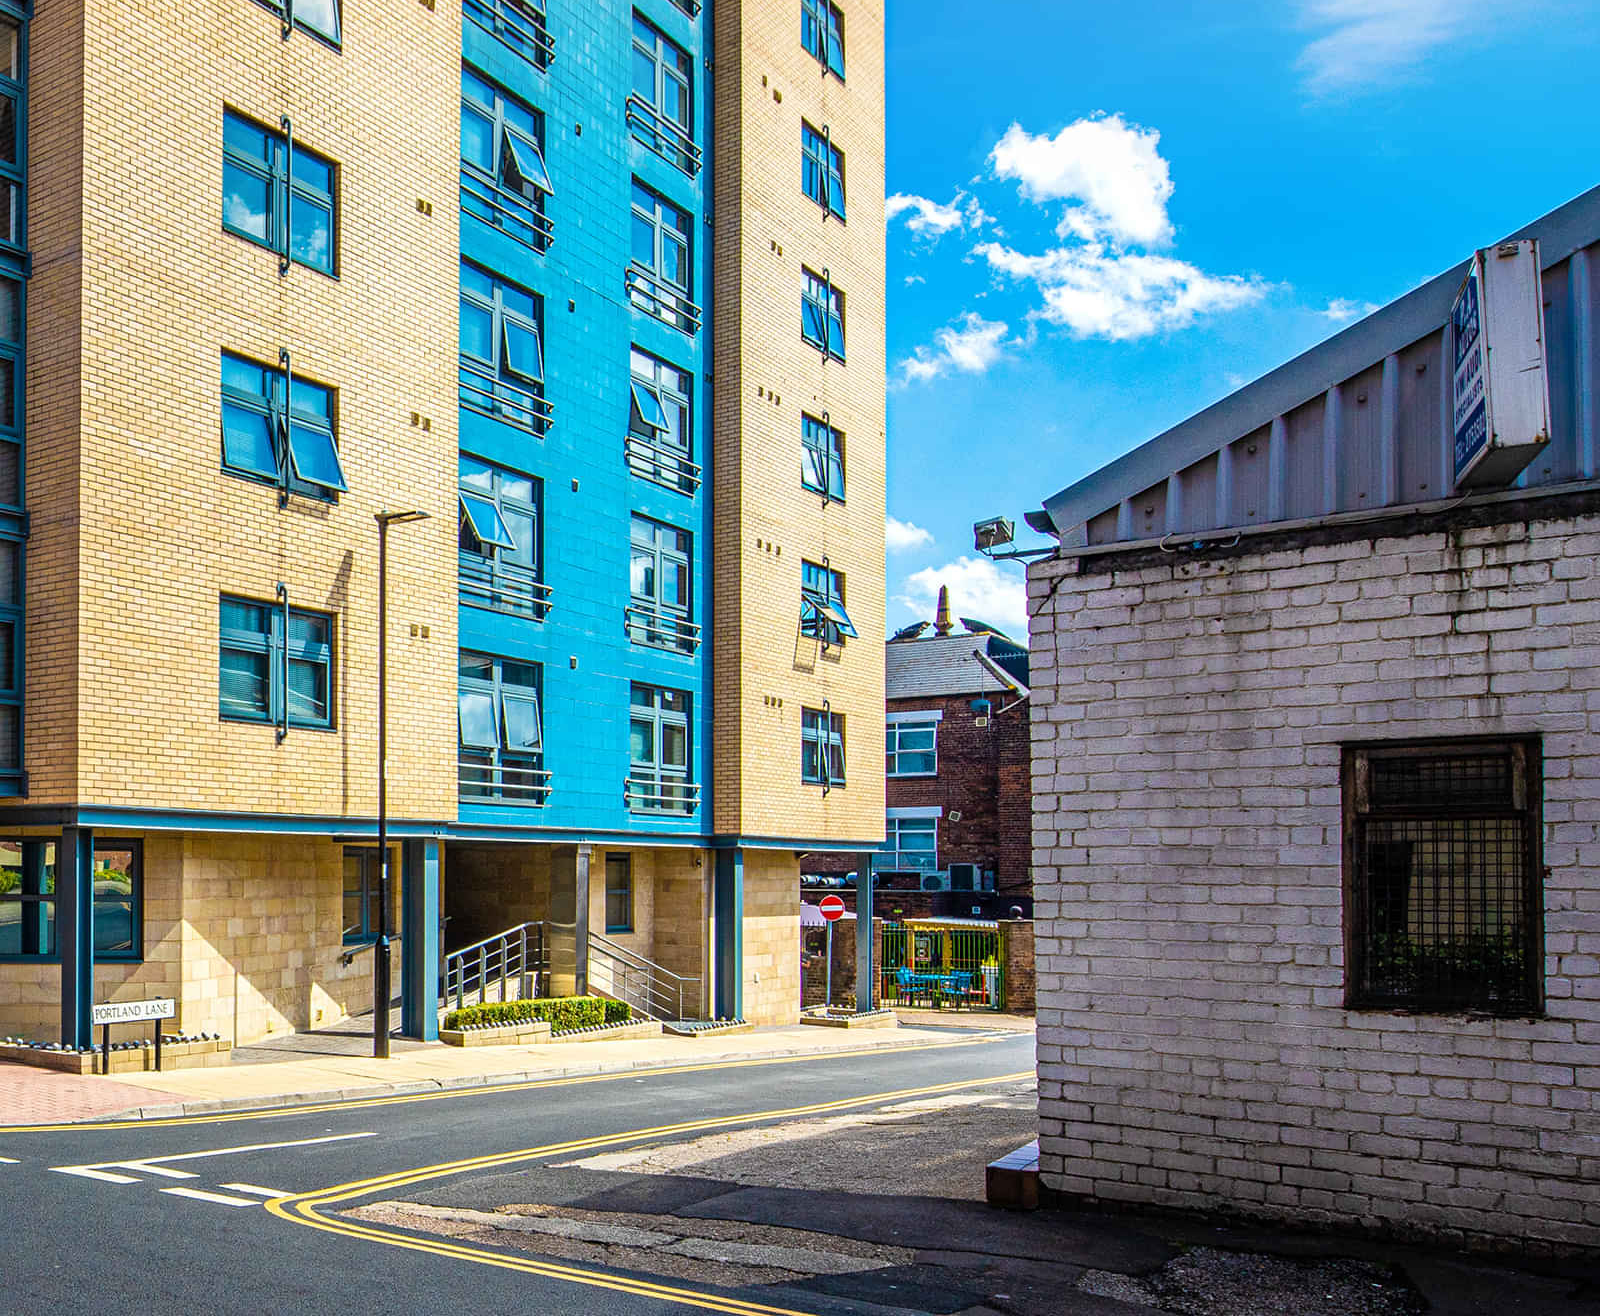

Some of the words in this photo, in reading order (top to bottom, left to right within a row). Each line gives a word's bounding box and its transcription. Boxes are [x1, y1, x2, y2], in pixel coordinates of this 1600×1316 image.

[1455, 374, 1483, 425] SPECIALISTS
[95, 1005, 141, 1020] PORTLAND
[145, 1003, 168, 1015] LANE
